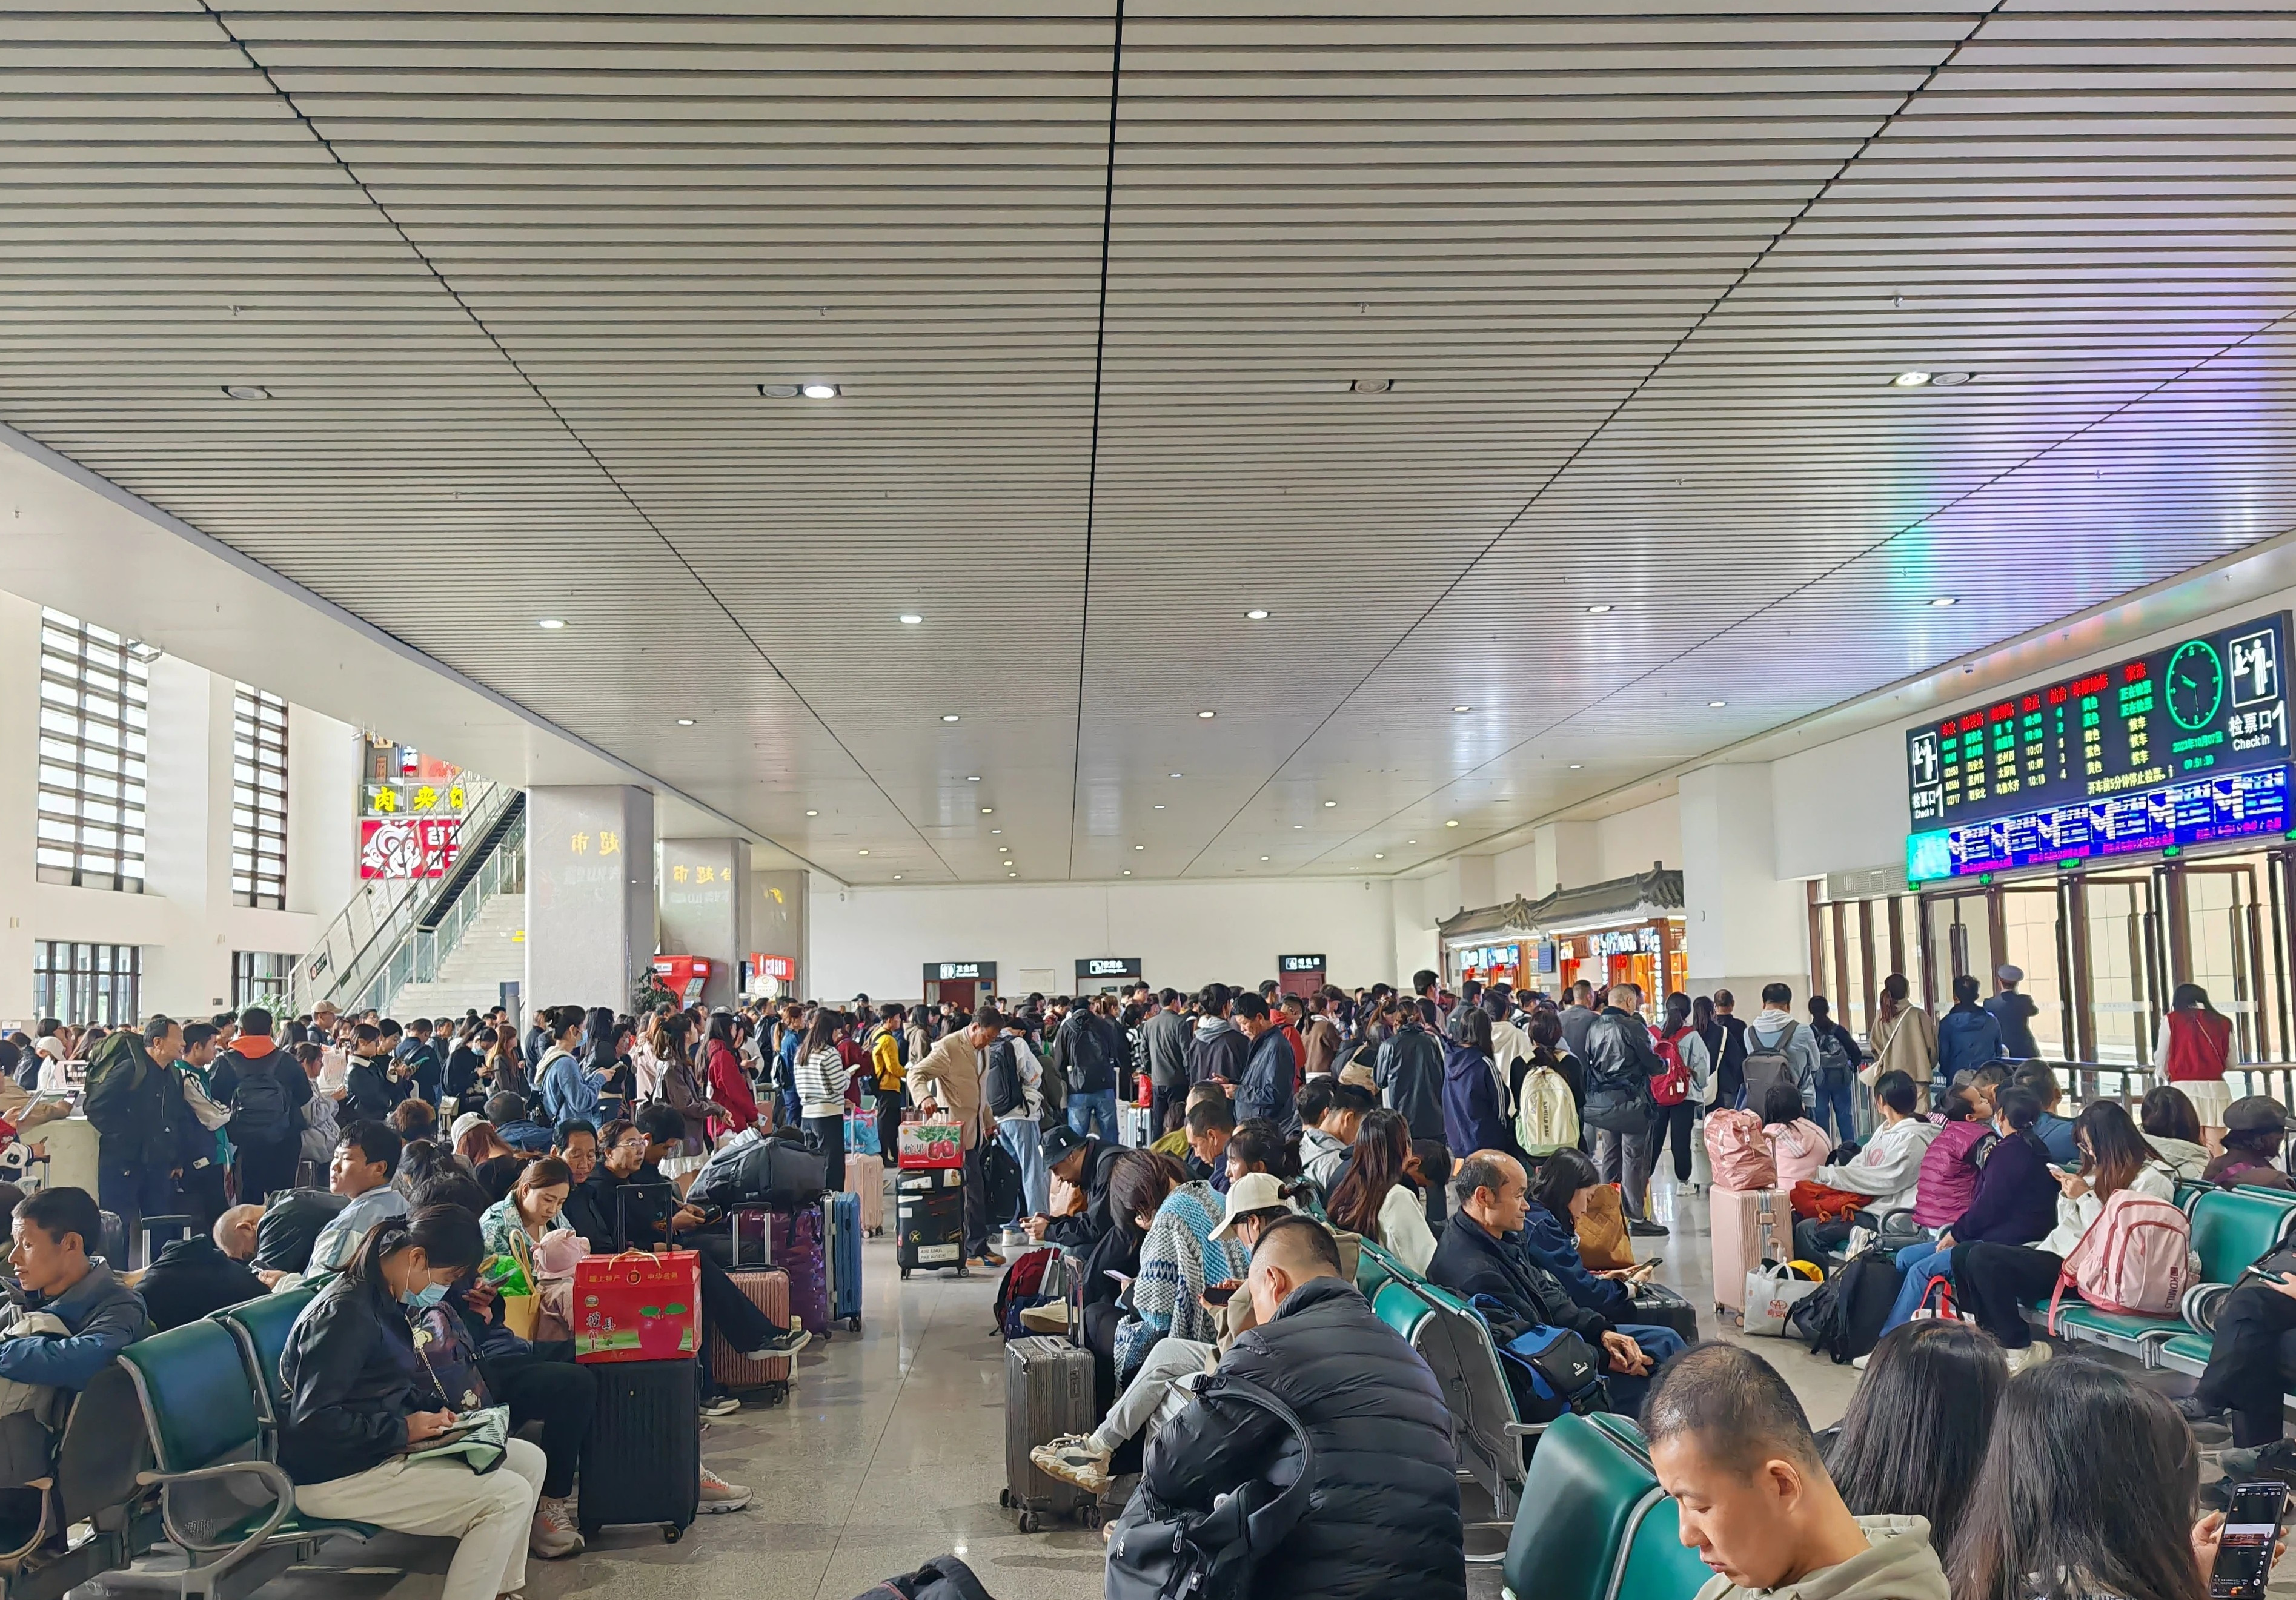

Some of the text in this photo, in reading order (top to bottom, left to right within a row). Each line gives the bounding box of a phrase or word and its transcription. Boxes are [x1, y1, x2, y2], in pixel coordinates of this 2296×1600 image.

[2119, 680, 2152, 701] 正在检票
[2120, 696, 2153, 717] 正在检票
[2229, 700, 2287, 746] 检票口 1
[1967, 758, 1984, 772] 西安北
[1996, 750, 2015, 765] 兰州西
[2026, 743, 2043, 756] 10:07
[2128, 715, 2147, 732] 候车
[1968, 772, 1985, 786] 兰州西
[1998, 765, 2016, 779] 太原南
[2028, 758, 2044, 771] 10:09
[2129, 732, 2148, 749] 候车
[2233, 734, 2271, 751] Check in
[1969, 787, 1986, 802] 西安北
[1996, 779, 2020, 795] 乌鲁木齐
[2131, 749, 2149, 766] 候车
[1913, 783, 1944, 817] 检票口 1
[1915, 808, 1929, 819] Check
